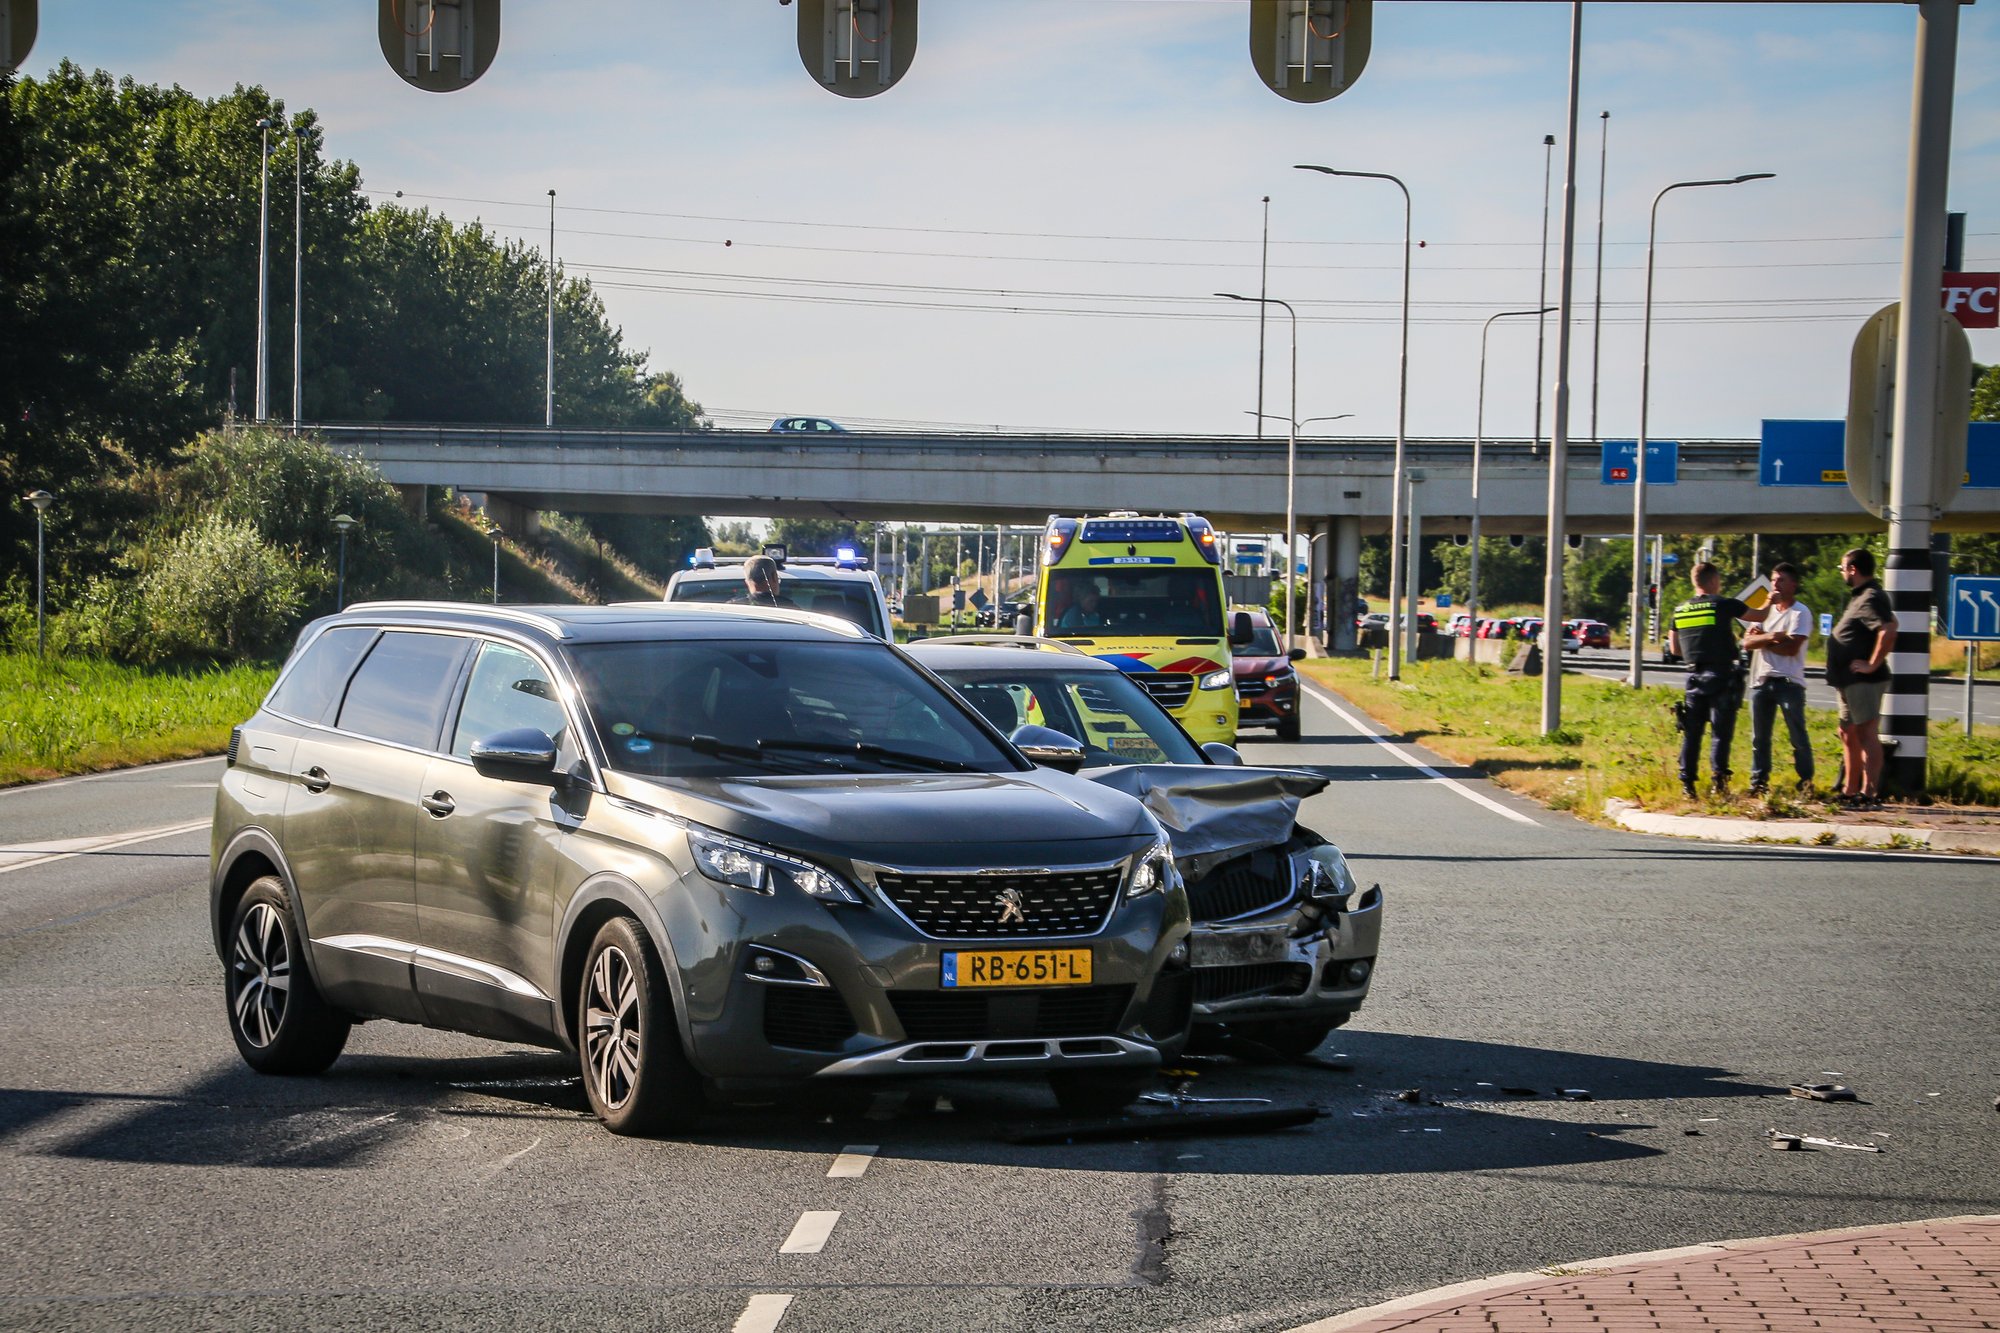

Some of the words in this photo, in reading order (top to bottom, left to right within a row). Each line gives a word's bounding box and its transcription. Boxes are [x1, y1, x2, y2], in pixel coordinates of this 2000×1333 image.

[1941, 286, 1998, 314] FC
[1620, 445, 1660, 455] Alre
[944, 972, 955, 981] NL
[971, 954, 1082, 982] RB-651-L
